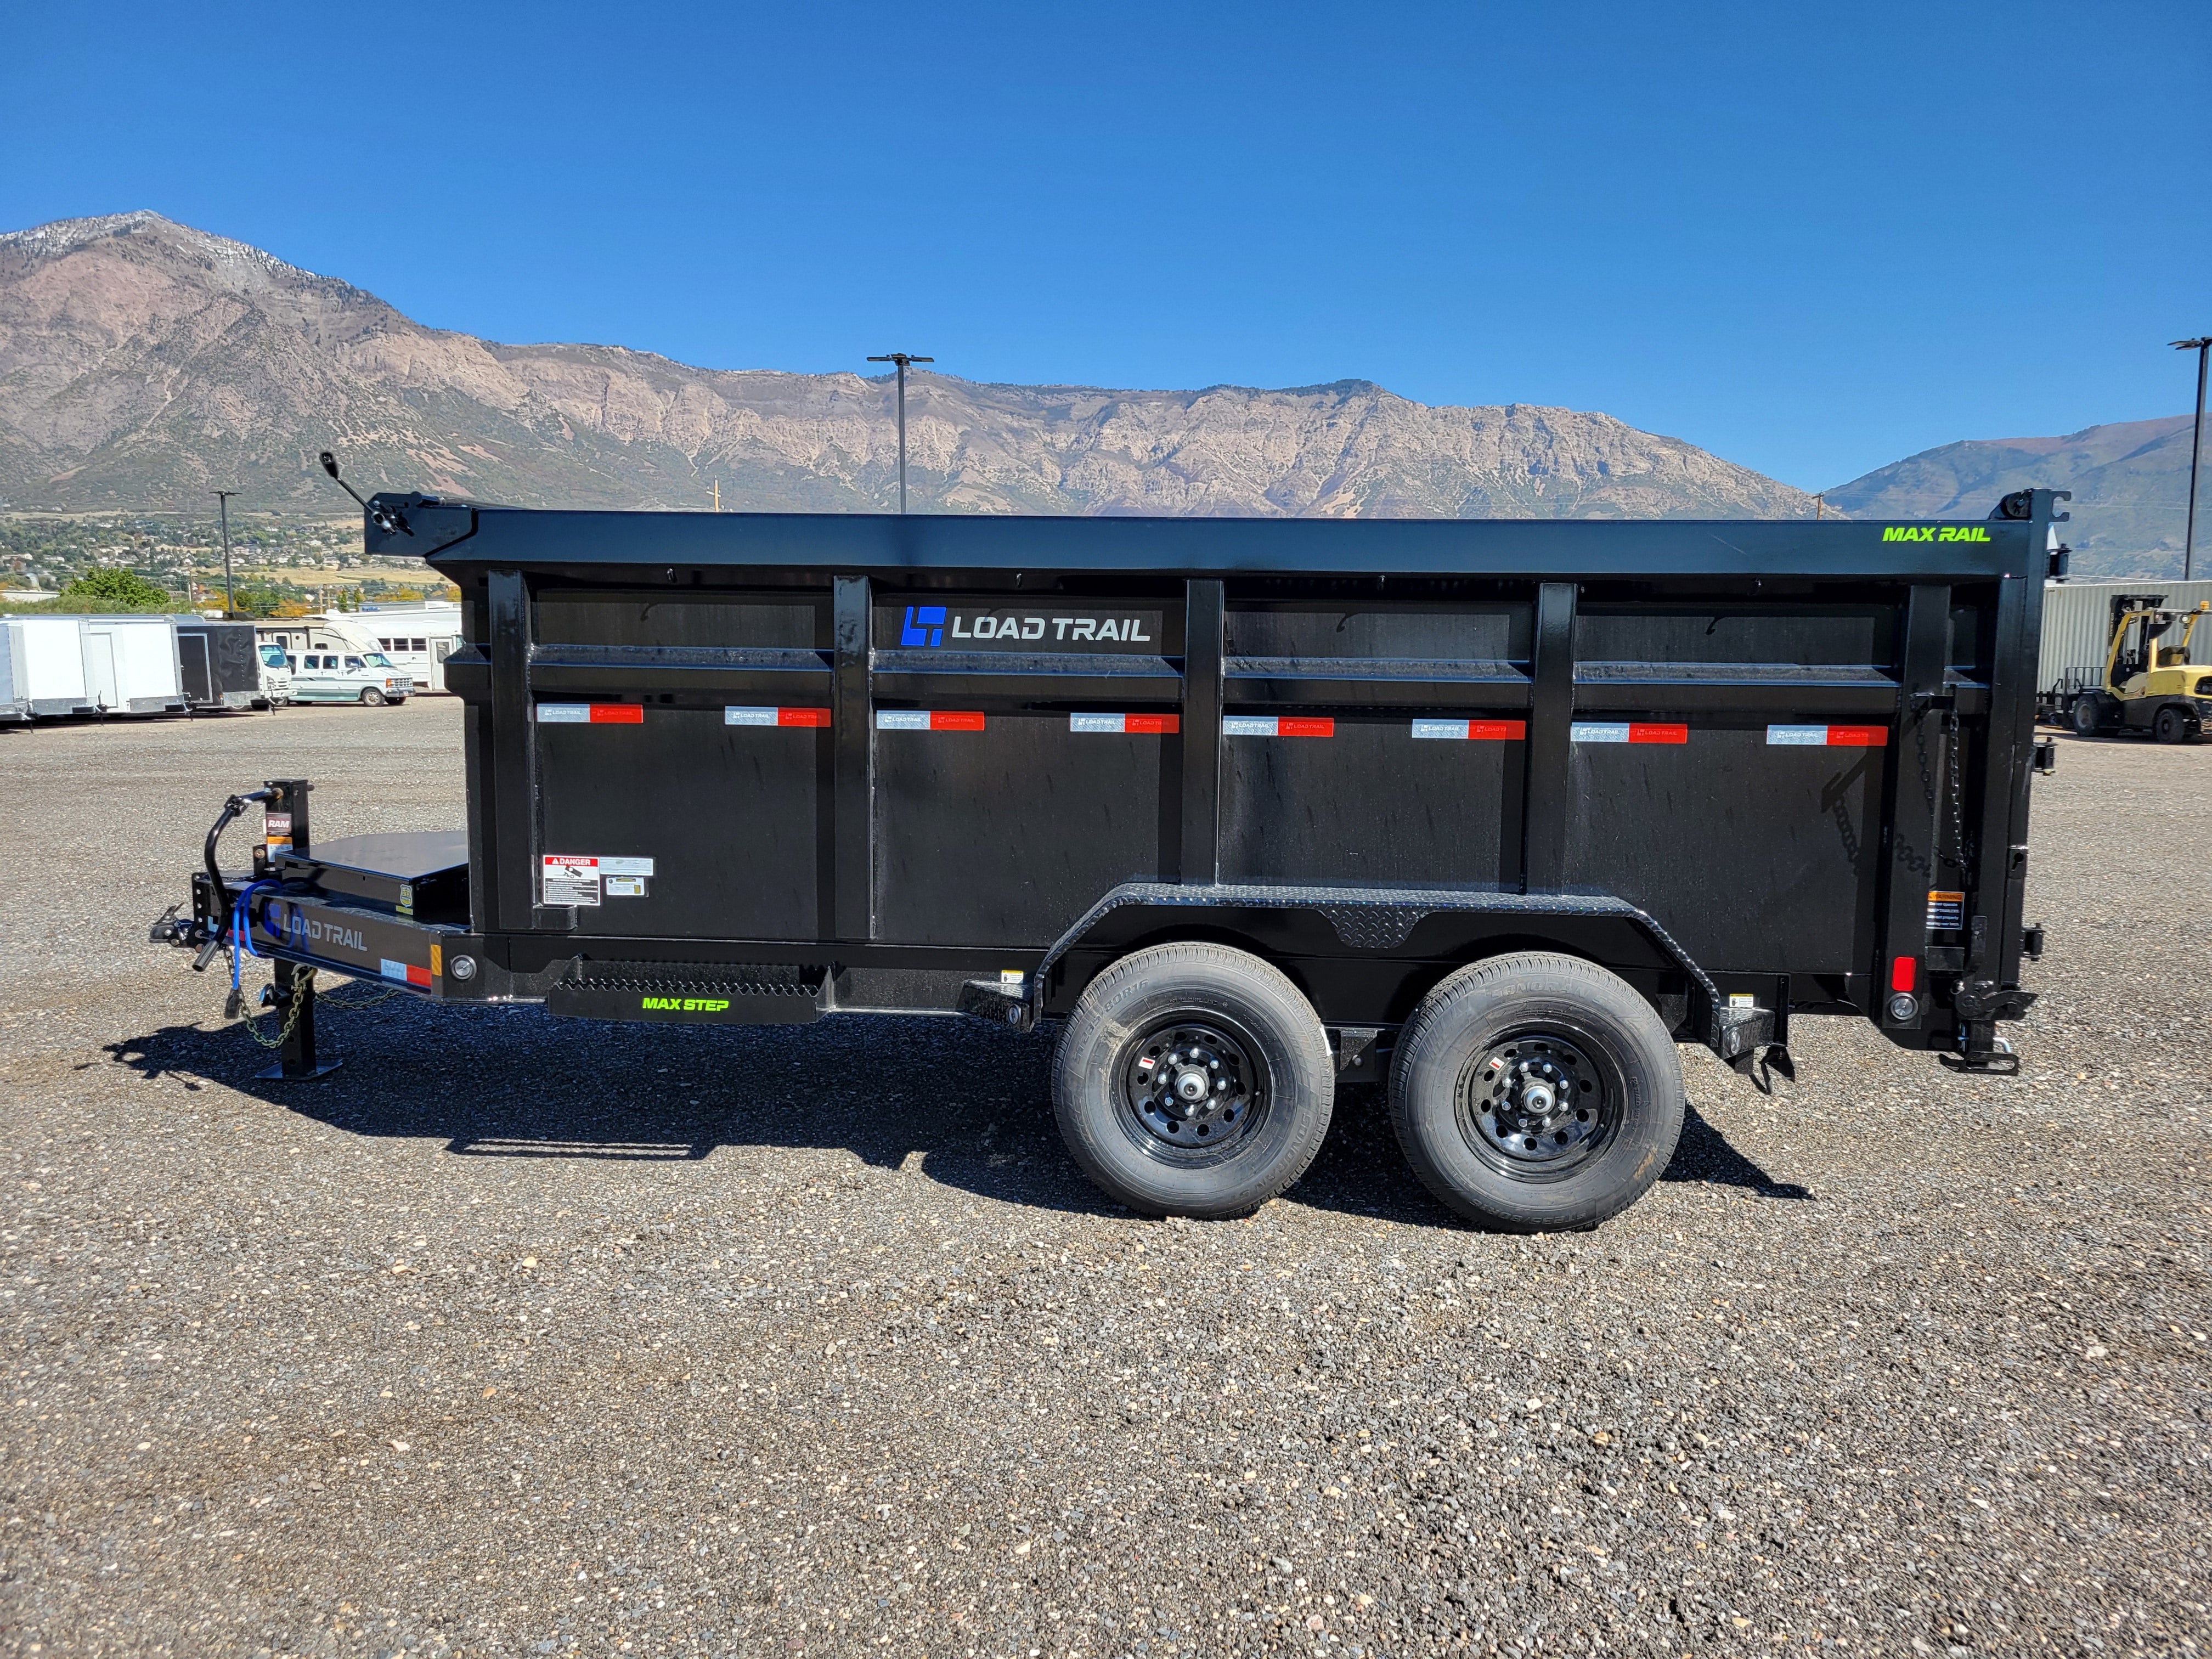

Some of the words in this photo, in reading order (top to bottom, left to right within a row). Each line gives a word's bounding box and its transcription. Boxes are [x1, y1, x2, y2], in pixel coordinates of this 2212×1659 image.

[1882, 527, 1937, 542] MAX
[1938, 527, 1991, 542] RAIL
[951, 616, 1046, 640] LOAD
[1052, 618, 1151, 642] TRAIL
[268, 820, 290, 828] RAM
[283, 913, 322, 940] LOAD
[323, 923, 368, 952] TRAIL
[642, 997, 682, 1011] MAX
[683, 998, 729, 1012] STEP
